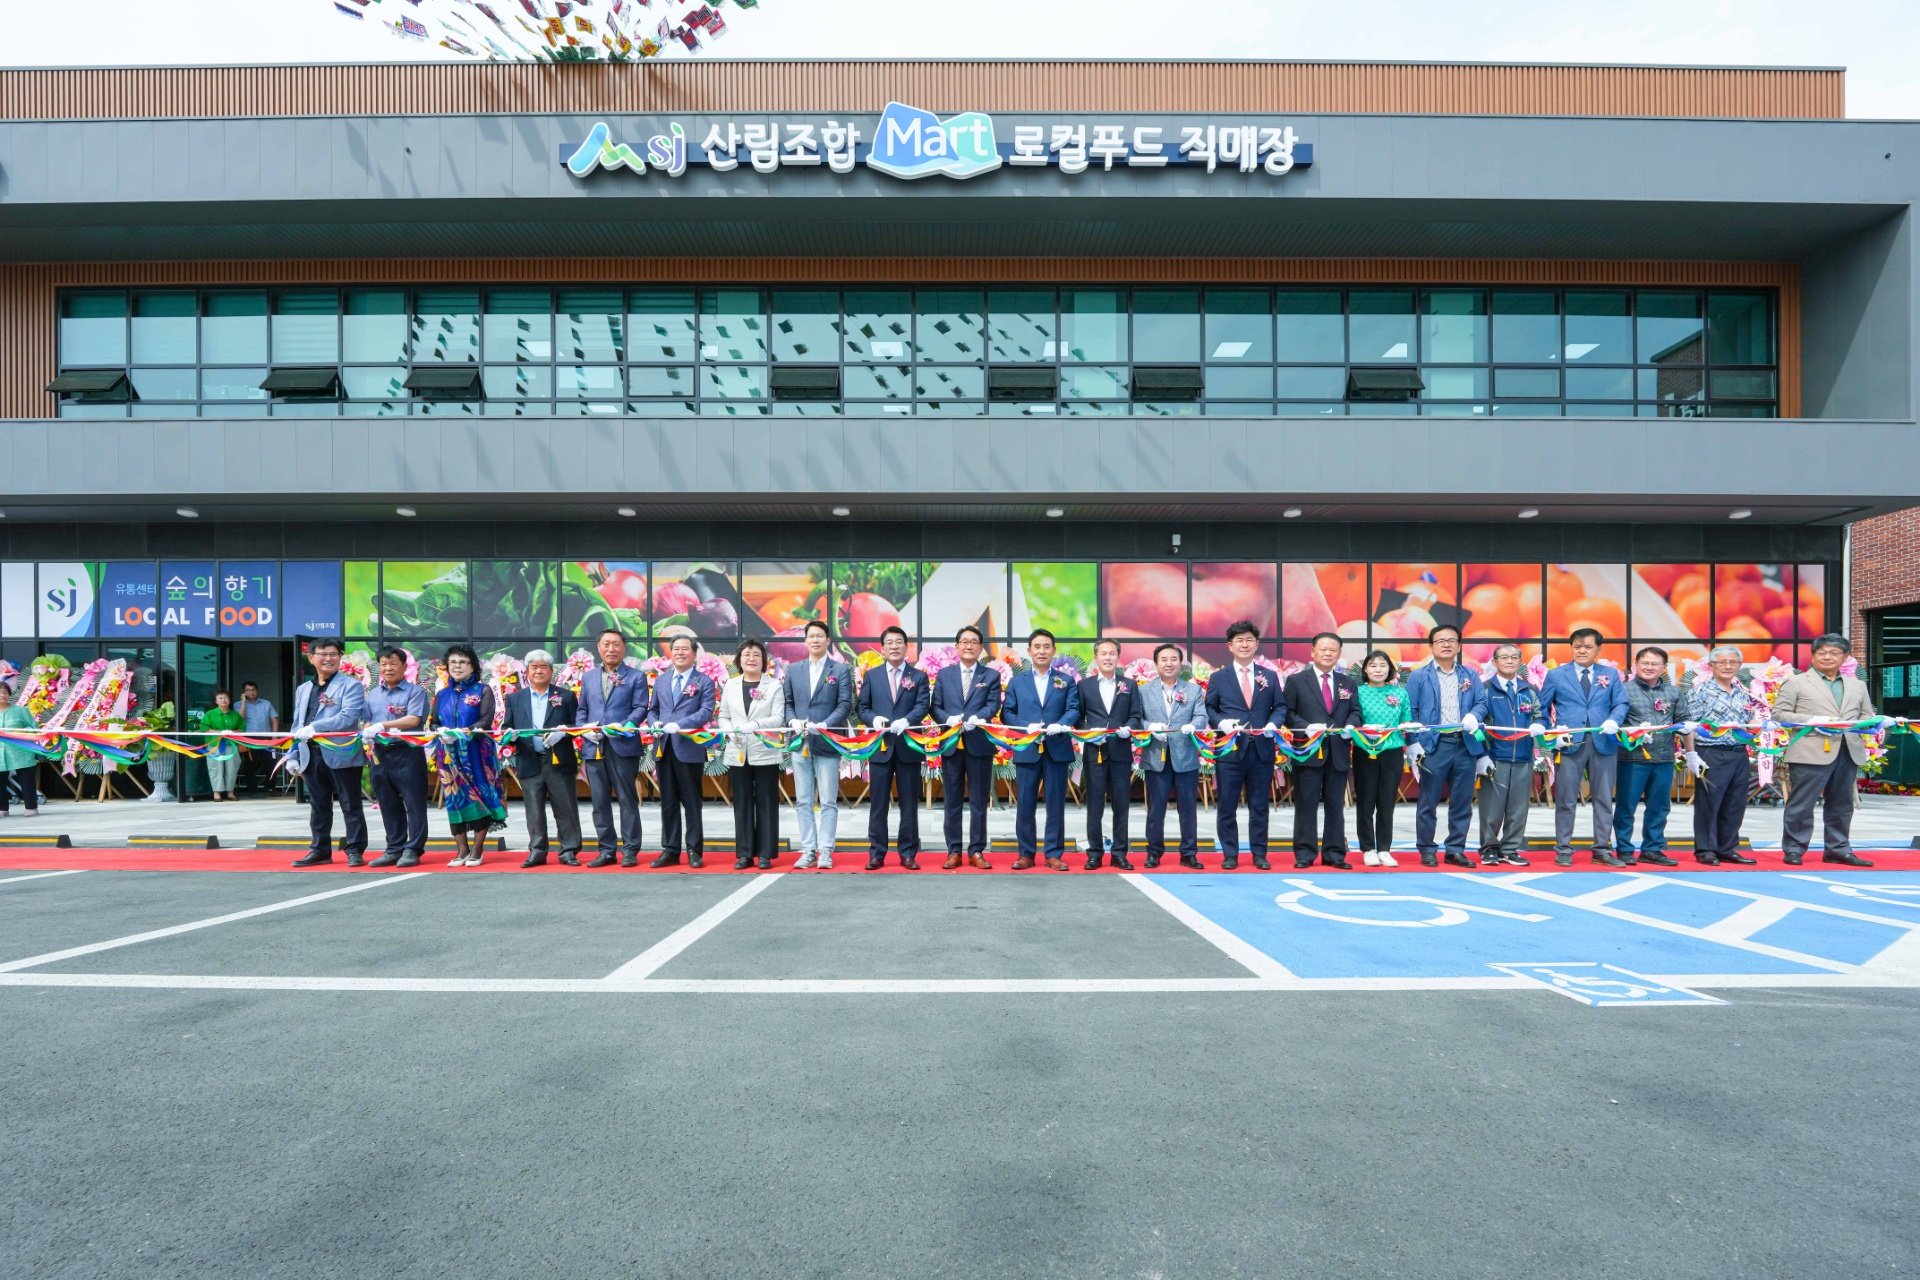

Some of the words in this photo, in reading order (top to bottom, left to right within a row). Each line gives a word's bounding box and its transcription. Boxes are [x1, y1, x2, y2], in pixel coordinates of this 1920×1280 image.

[648, 121, 687, 177] sj
[701, 121, 861, 174] 산림조합
[886, 117, 989, 157] Mart
[1009, 124, 1169, 174] 로컬푸드
[1179, 125, 1299, 176] 직매장
[47, 577, 77, 617] sj
[115, 583, 157, 596] 유통센터
[165, 575, 213, 601] 숲의
[224, 575, 272, 601] 향기
[115, 606, 191, 626] LOCAL
[204, 606, 273, 626] FOOD
